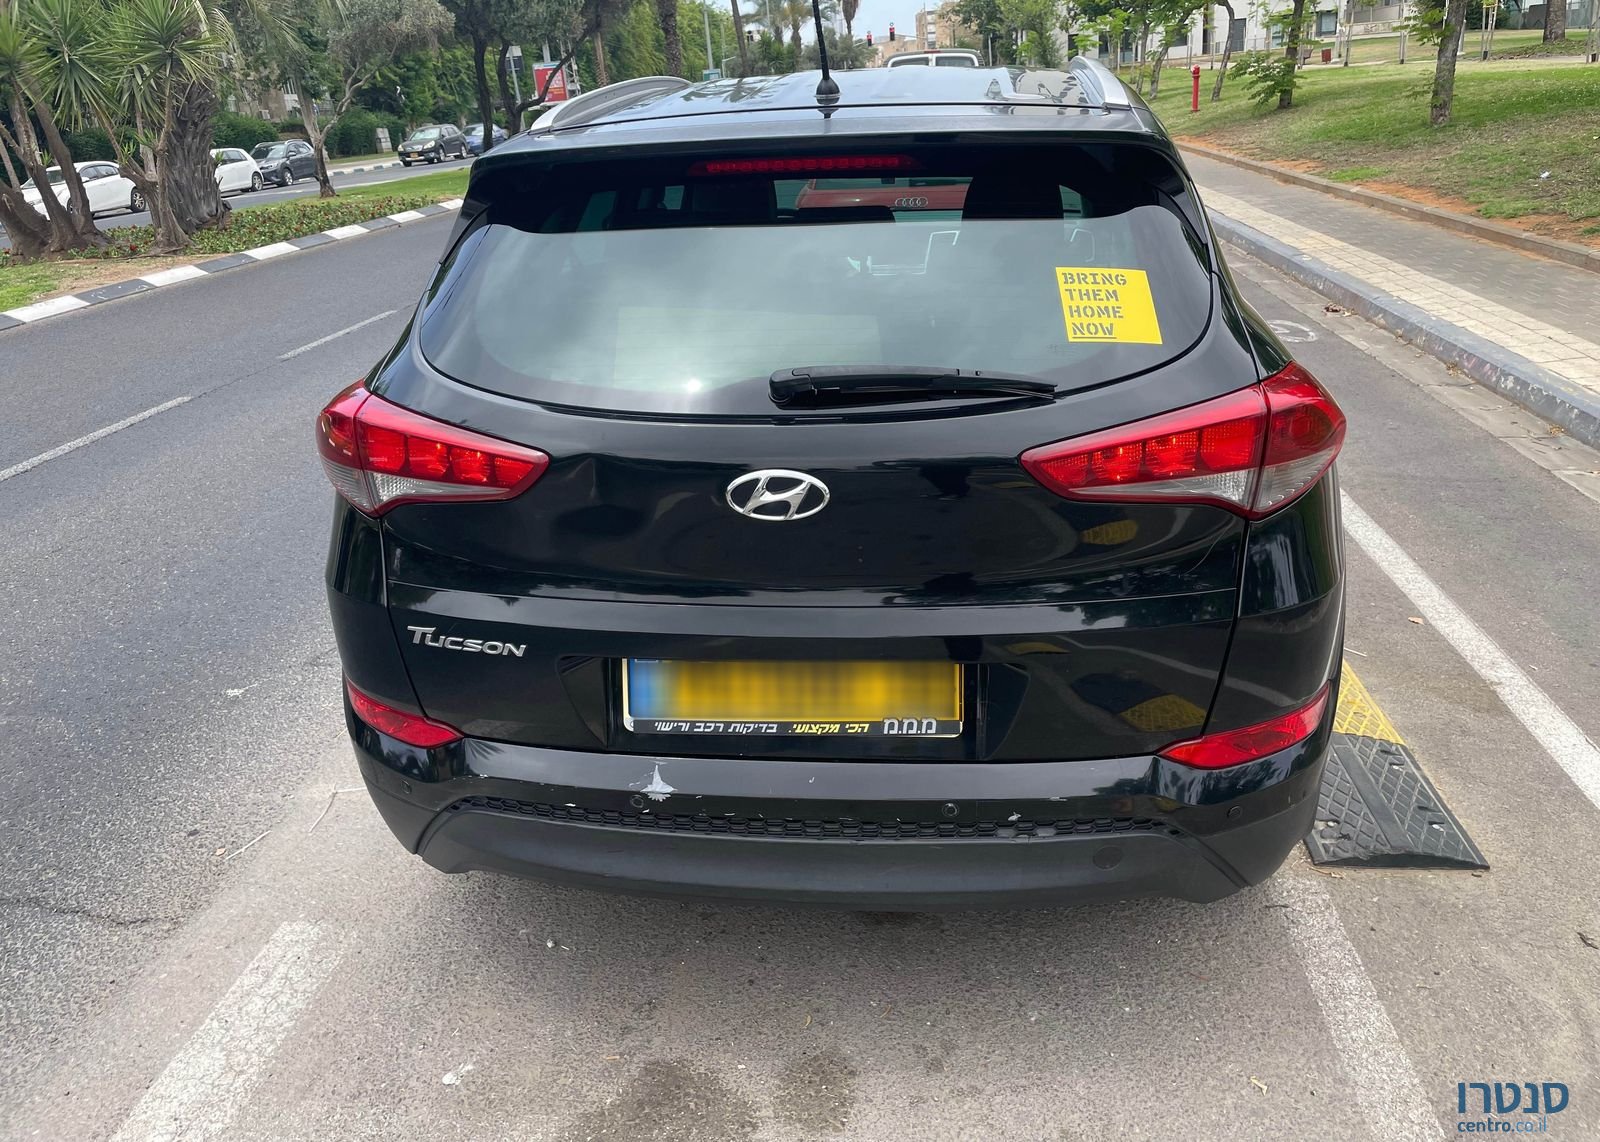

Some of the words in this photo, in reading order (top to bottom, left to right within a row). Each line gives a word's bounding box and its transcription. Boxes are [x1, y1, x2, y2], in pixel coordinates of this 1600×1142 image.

[1062, 272, 1127, 286] BRING
[1065, 289, 1119, 302] THEM
[1068, 305, 1124, 319] HOME
[1072, 322, 1114, 336] NOW
[654, 721, 690, 732] ורישוי
[693, 722, 724, 732] רכב
[728, 723, 777, 734] בדיקות
[788, 723, 840, 734] מקצועי.
[845, 723, 869, 733] הכי
